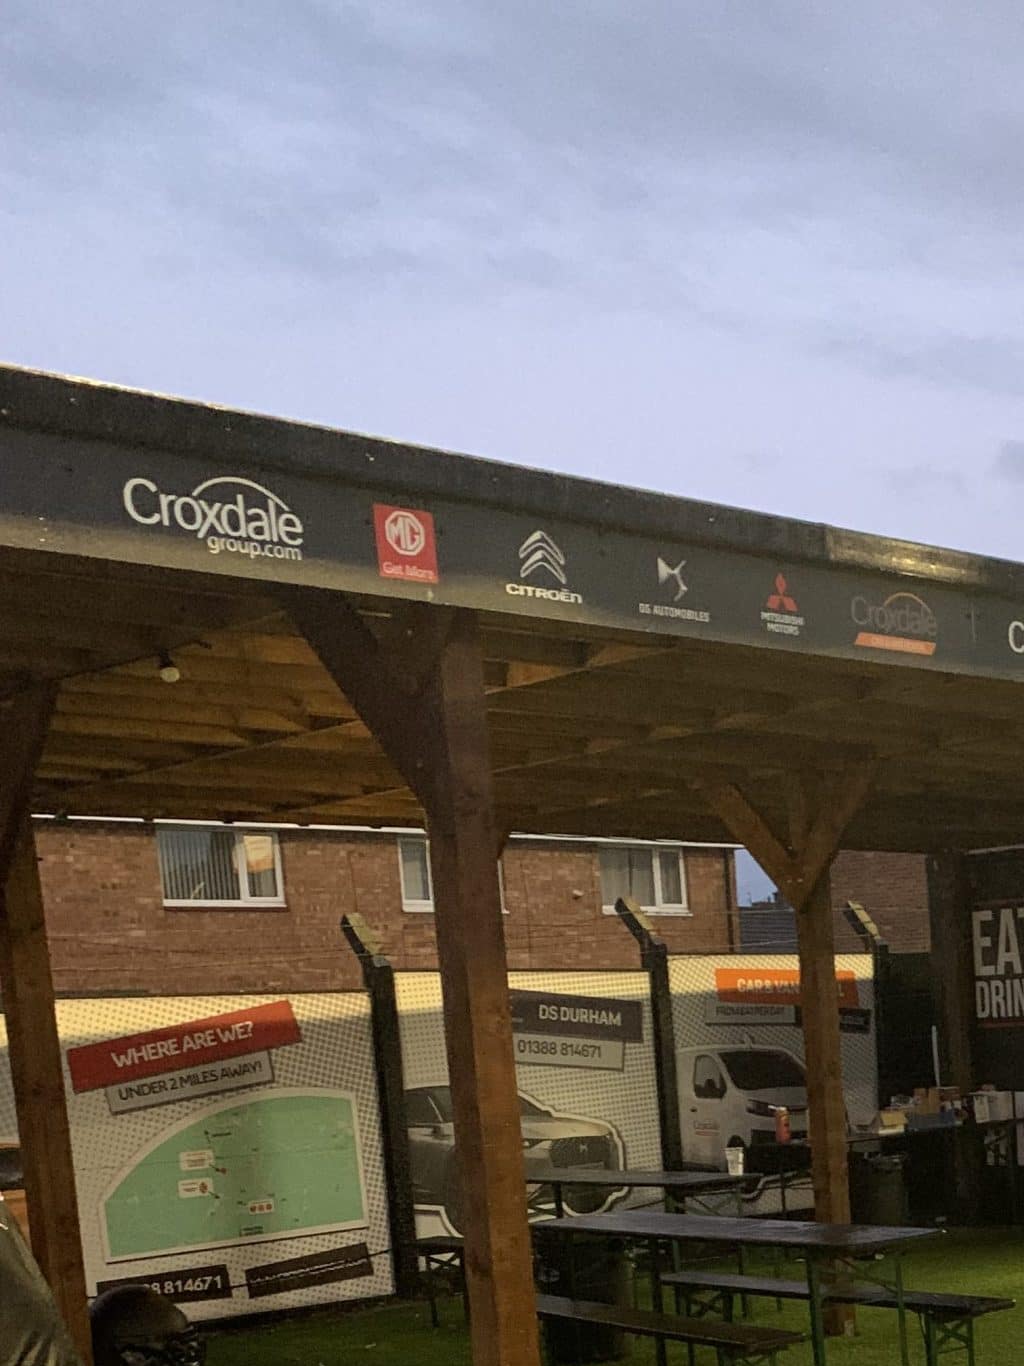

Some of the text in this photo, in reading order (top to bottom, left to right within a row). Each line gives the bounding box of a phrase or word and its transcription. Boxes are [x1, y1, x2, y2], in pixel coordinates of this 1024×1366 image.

[123, 477, 304, 546] Croxdale
[386, 513, 423, 553] MG
[206, 536, 303, 561] group.com
[652, 605, 711, 623] AUTOMOBILES
[851, 596, 938, 638] Croxdale
[767, 623, 800, 636] MOTORS
[538, 1004, 622, 1026] DS DURHAM
[111, 1021, 254, 1068] WHERE ARE WE?
[517, 1040, 602, 1059] 01388 814671
[118, 1060, 263, 1100] UNDER 2 MILES AWAY!
[163, 1274, 223, 1295] 814671
